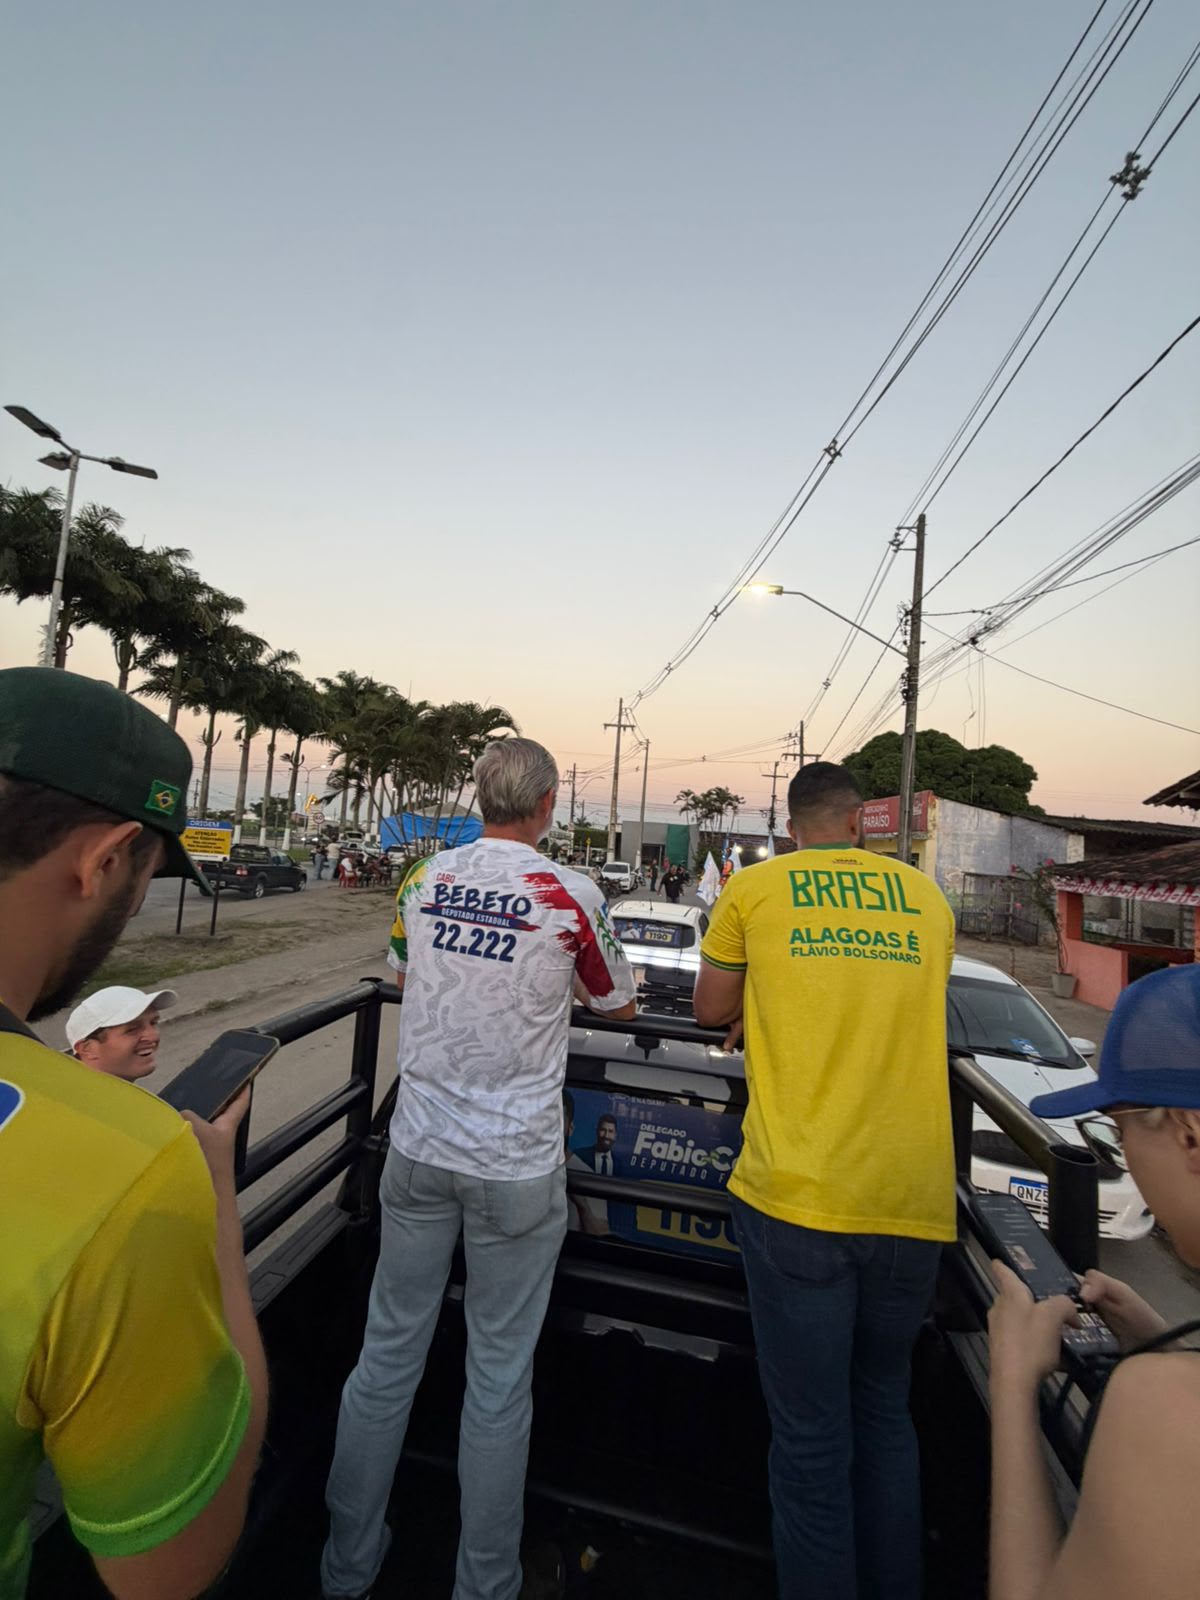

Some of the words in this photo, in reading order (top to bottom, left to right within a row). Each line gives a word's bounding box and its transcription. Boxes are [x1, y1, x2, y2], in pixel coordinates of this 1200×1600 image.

[436, 872, 456, 884] CABO
[433, 883, 532, 916] BEBETO
[788, 869, 921, 915] BRASIL
[441, 908, 475, 920] DEPUTADO
[475, 914, 511, 927] ESTADUAL
[432, 921, 517, 963] 22.222
[789, 927, 900, 949] ALAGOAS
[907, 930, 920, 952] É
[791, 944, 840, 957] FLÁVIO
[843, 947, 921, 965] BOLSONARO
[640, 1123, 687, 1138] DELEGADO
[630, 1155, 708, 1180] DEPUTADO
[1017, 1185, 1049, 1203] QNZ5
